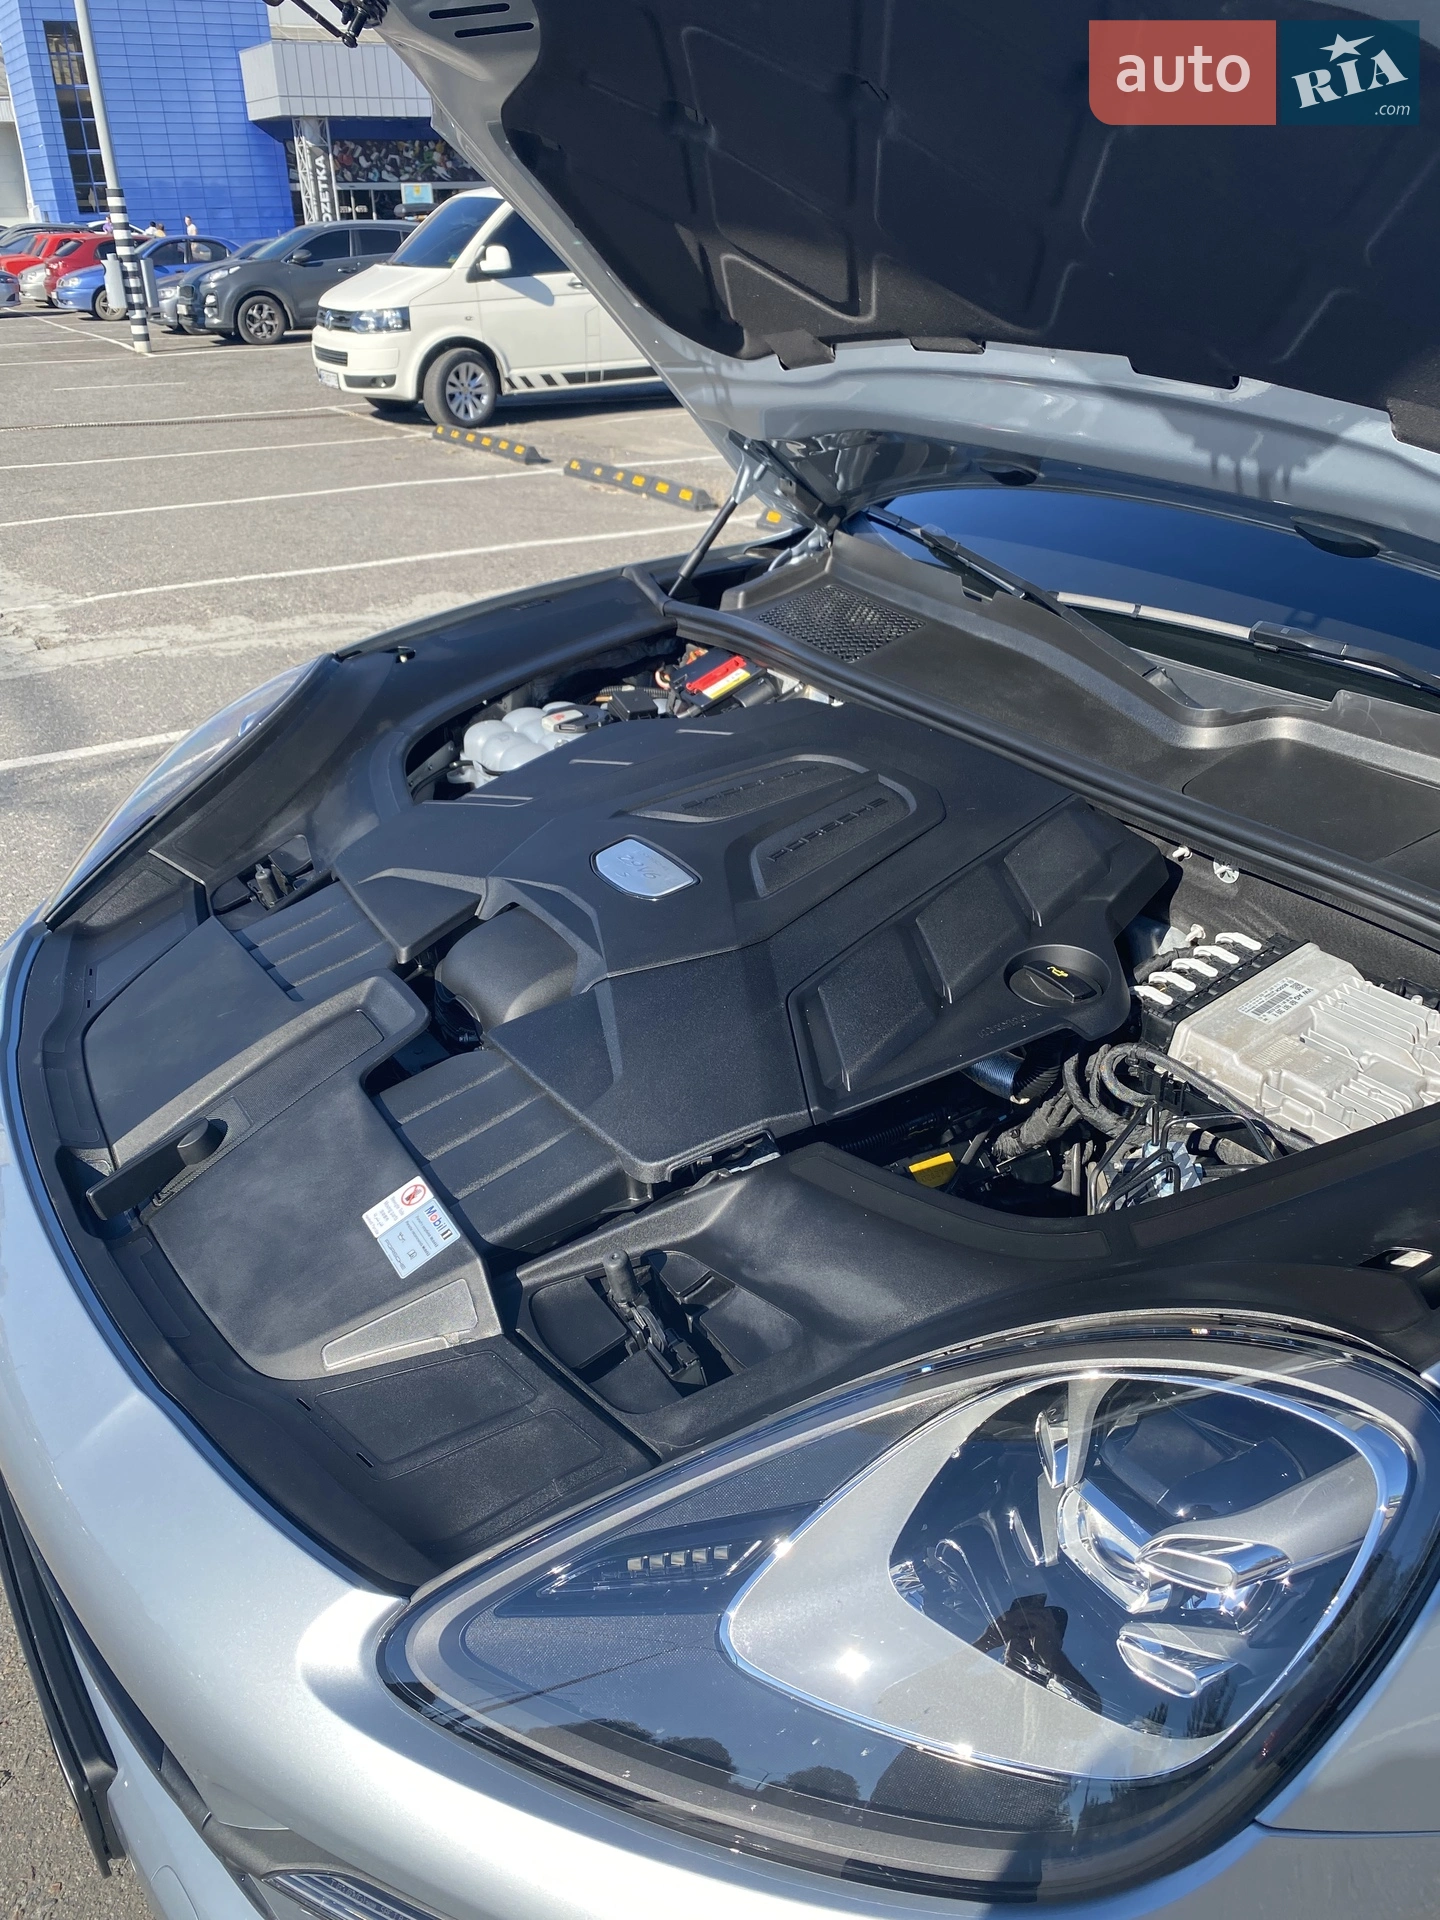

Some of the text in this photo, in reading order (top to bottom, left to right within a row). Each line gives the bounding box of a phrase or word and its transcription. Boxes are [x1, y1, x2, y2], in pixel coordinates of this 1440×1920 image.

[766, 797, 888, 862] PORSCHE
[424, 1205, 447, 1232] Mobil
[441, 1228, 454, 1241] 1
[384, 1239, 407, 1271] PORSCHE
